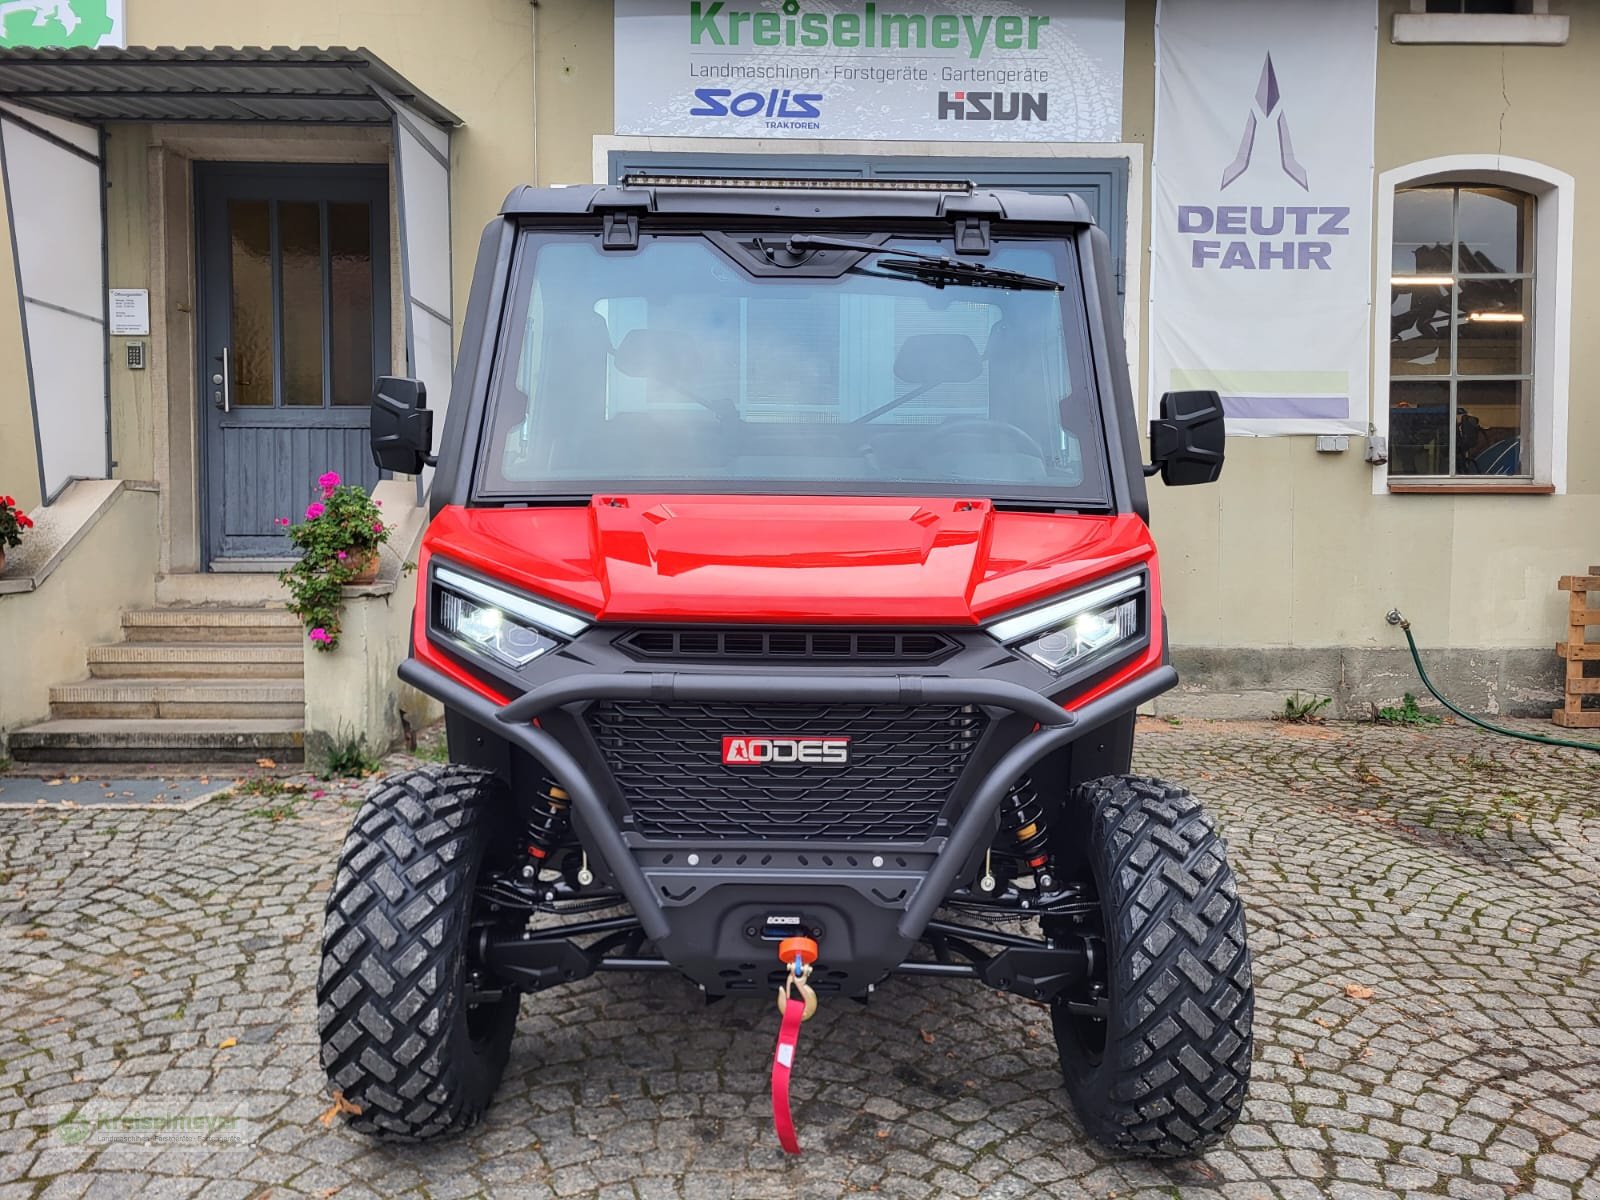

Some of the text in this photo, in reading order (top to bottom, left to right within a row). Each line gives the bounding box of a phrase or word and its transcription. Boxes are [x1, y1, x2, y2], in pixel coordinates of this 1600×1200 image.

[691, 1, 1049, 58] Kreiselmeyer
[690, 63, 1049, 85] Landmaschinen Forstgeräte Gartengeräte
[765, 121, 820, 130] TRAKTOREN
[1177, 205, 1350, 235] DEUTZ
[1192, 240, 1332, 270] FAHR
[726, 739, 848, 762] AODES
